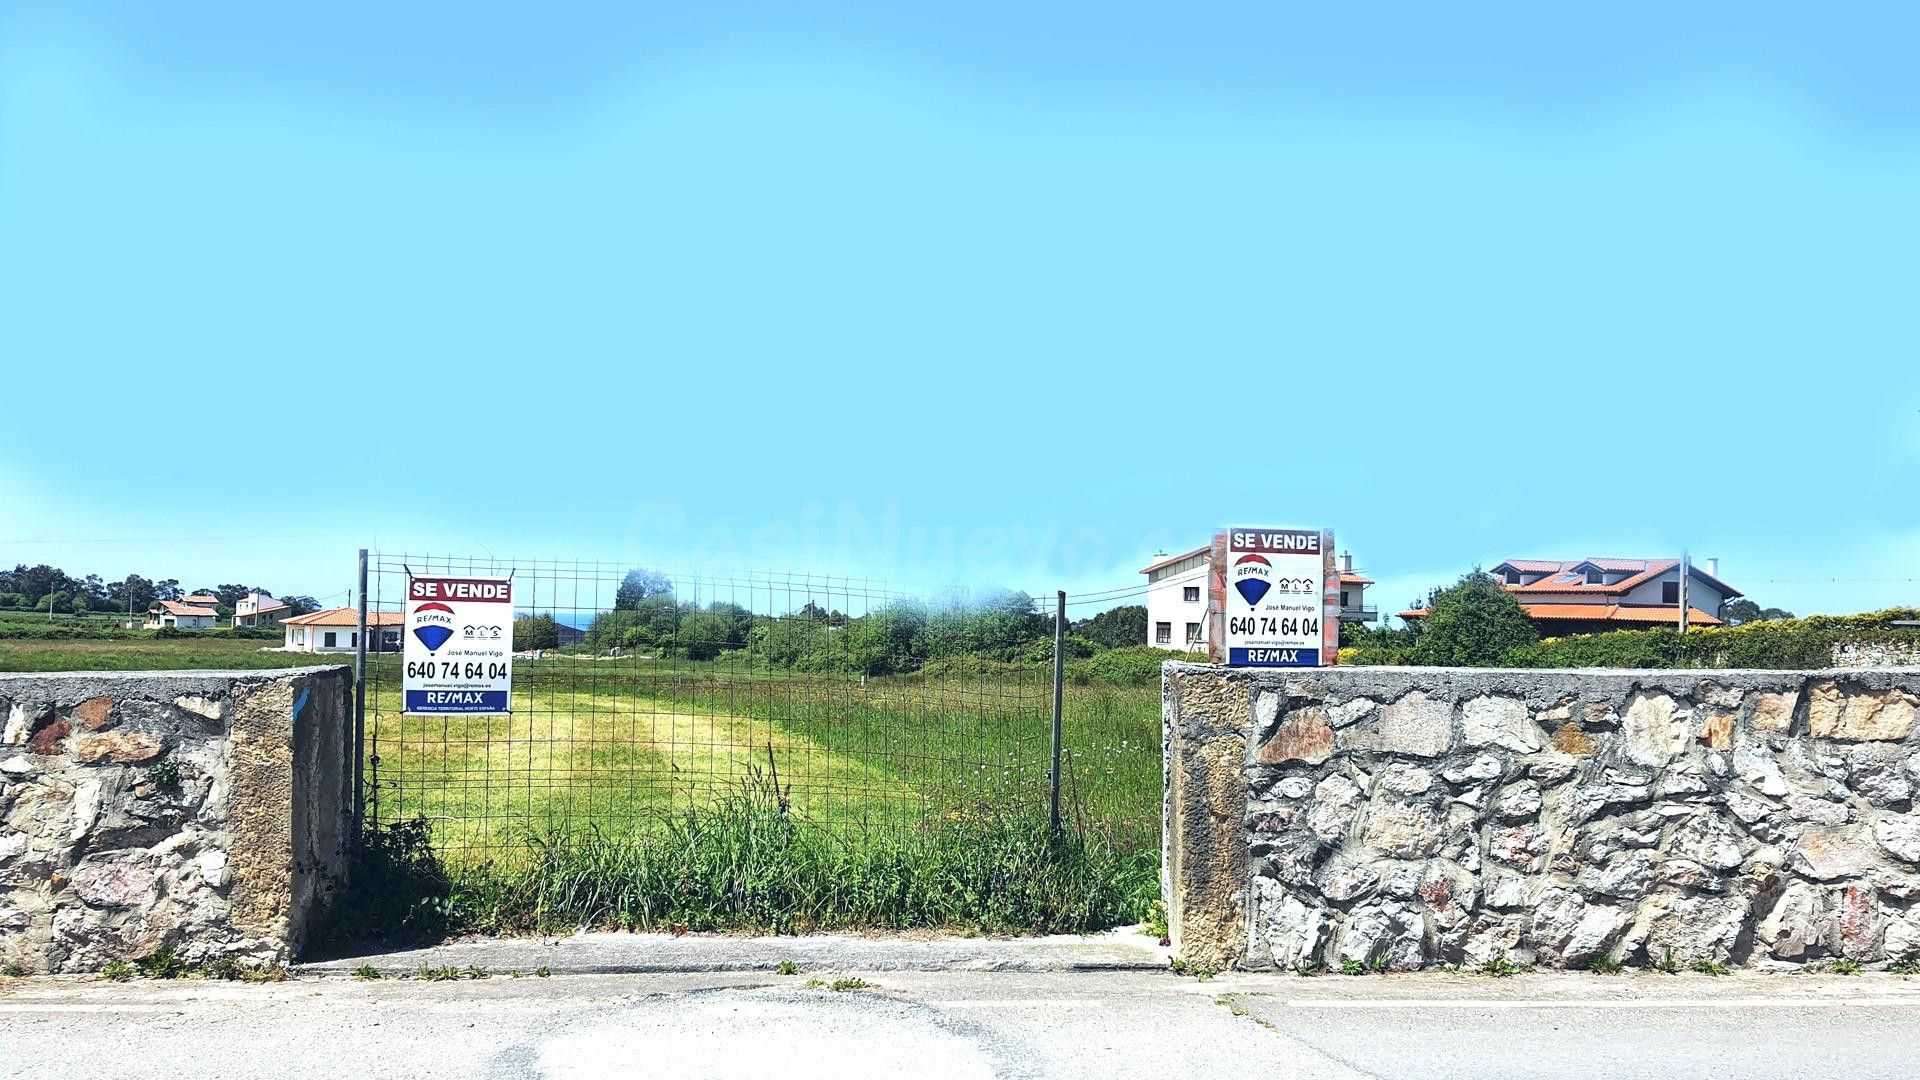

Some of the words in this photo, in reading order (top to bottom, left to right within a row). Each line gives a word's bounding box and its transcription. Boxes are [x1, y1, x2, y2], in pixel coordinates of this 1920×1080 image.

[1233, 533, 1256, 548] SE
[1261, 534, 1318, 550] VENDE
[1237, 567, 1270, 577] RE/MAX
[413, 583, 438, 597] SE
[443, 583, 508, 599] VENDE
[416, 615, 452, 624] RE/MAX
[1230, 617, 1256, 635] 640
[1260, 617, 1277, 636] 74
[1281, 618, 1298, 636] 64
[1302, 618, 1319, 636] 04
[1248, 650, 1298, 662] RE/MAX
[407, 662, 436, 679] 640
[441, 662, 460, 679] 74
[465, 662, 484, 679] 64
[488, 662, 507, 680] 04
[427, 692, 484, 703] RE/MAX
